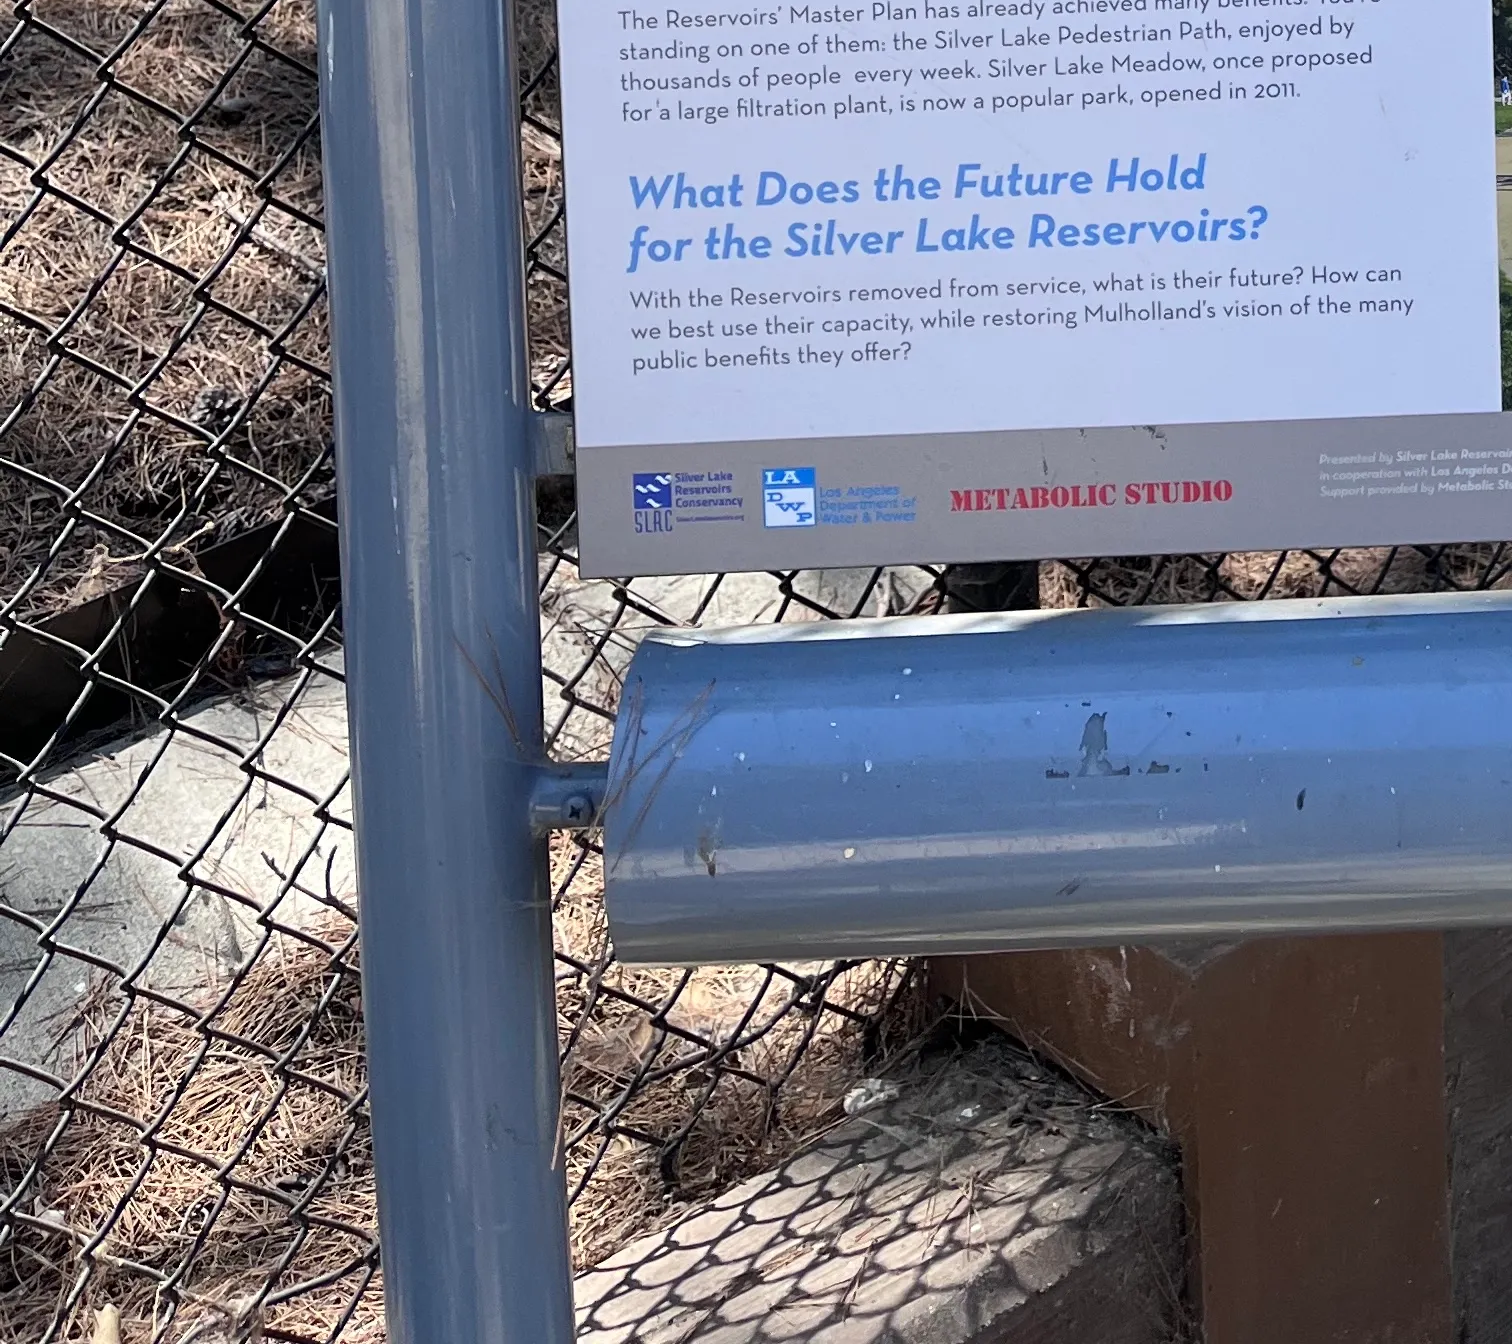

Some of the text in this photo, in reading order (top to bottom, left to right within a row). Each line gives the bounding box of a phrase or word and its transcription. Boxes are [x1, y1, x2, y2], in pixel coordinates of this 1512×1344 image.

[628, 152, 1207, 210] What Does the Future Hold
[626, 205, 1269, 274] for the Silver Lake Reservoirs?
[633, 341, 912, 376] public benefits they offer?
[1395, 450, 1428, 462] Silver
[1430, 449, 1458, 461] Lake
[707, 471, 734, 482] Lake
[764, 470, 801, 486] LA
[674, 483, 732, 496] Reservoirs
[951, 480, 1234, 512] METABOLIC STUDIO
[675, 496, 744, 509] Conservancy
[634, 510, 673, 534] SLRC
